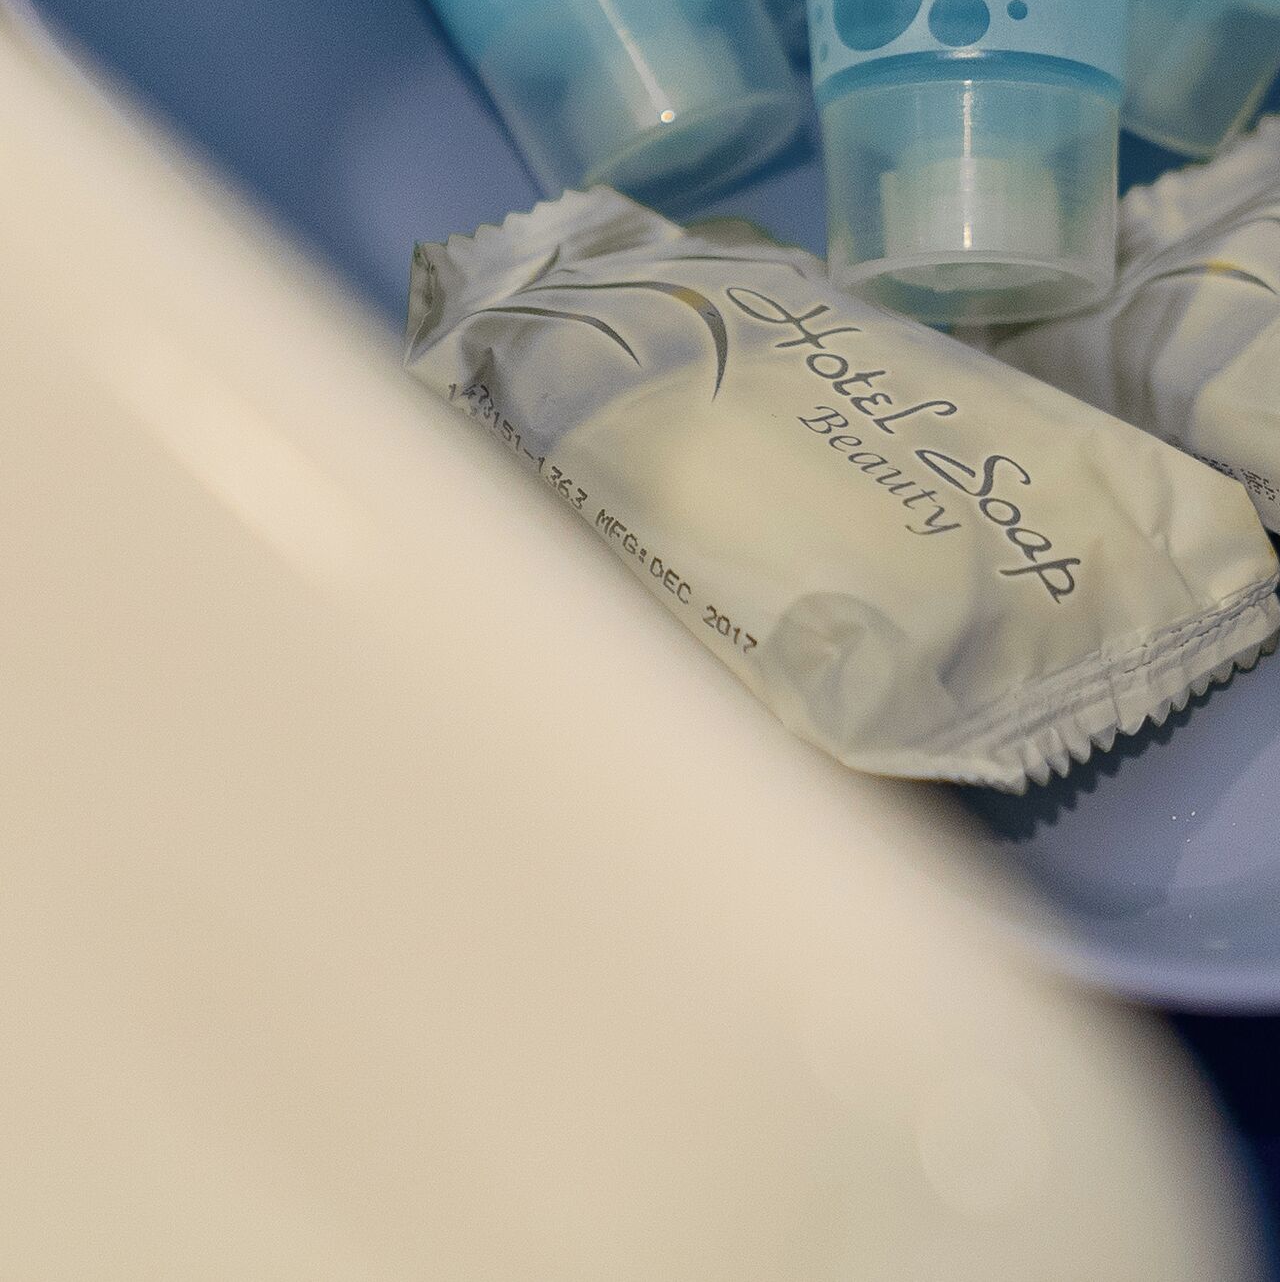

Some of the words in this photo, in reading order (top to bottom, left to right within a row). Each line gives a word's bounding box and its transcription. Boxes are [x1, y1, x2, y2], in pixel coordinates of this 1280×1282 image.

[795, 405, 963, 537] Beauty
[914, 448, 1082, 605] Soap
[702, 604, 758, 654] 2017
